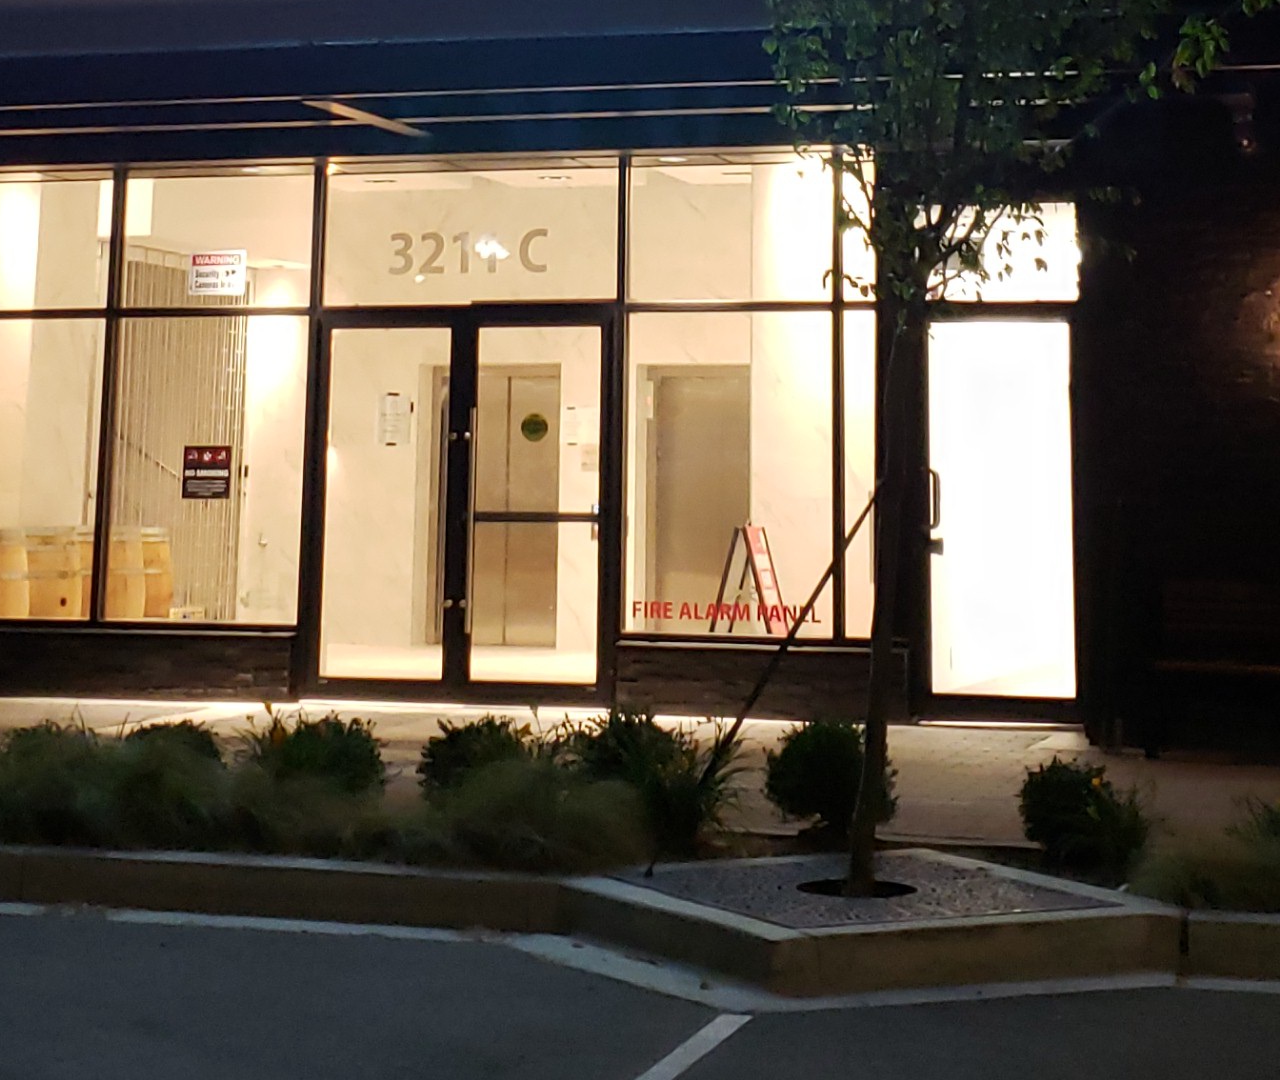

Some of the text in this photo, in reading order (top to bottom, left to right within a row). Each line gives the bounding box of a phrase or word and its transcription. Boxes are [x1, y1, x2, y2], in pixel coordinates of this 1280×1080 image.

[194, 255, 240, 265] WARNING
[518, 228, 549, 273] C
[632, 601, 674, 620] FIRE
[678, 602, 751, 622] ALARM
